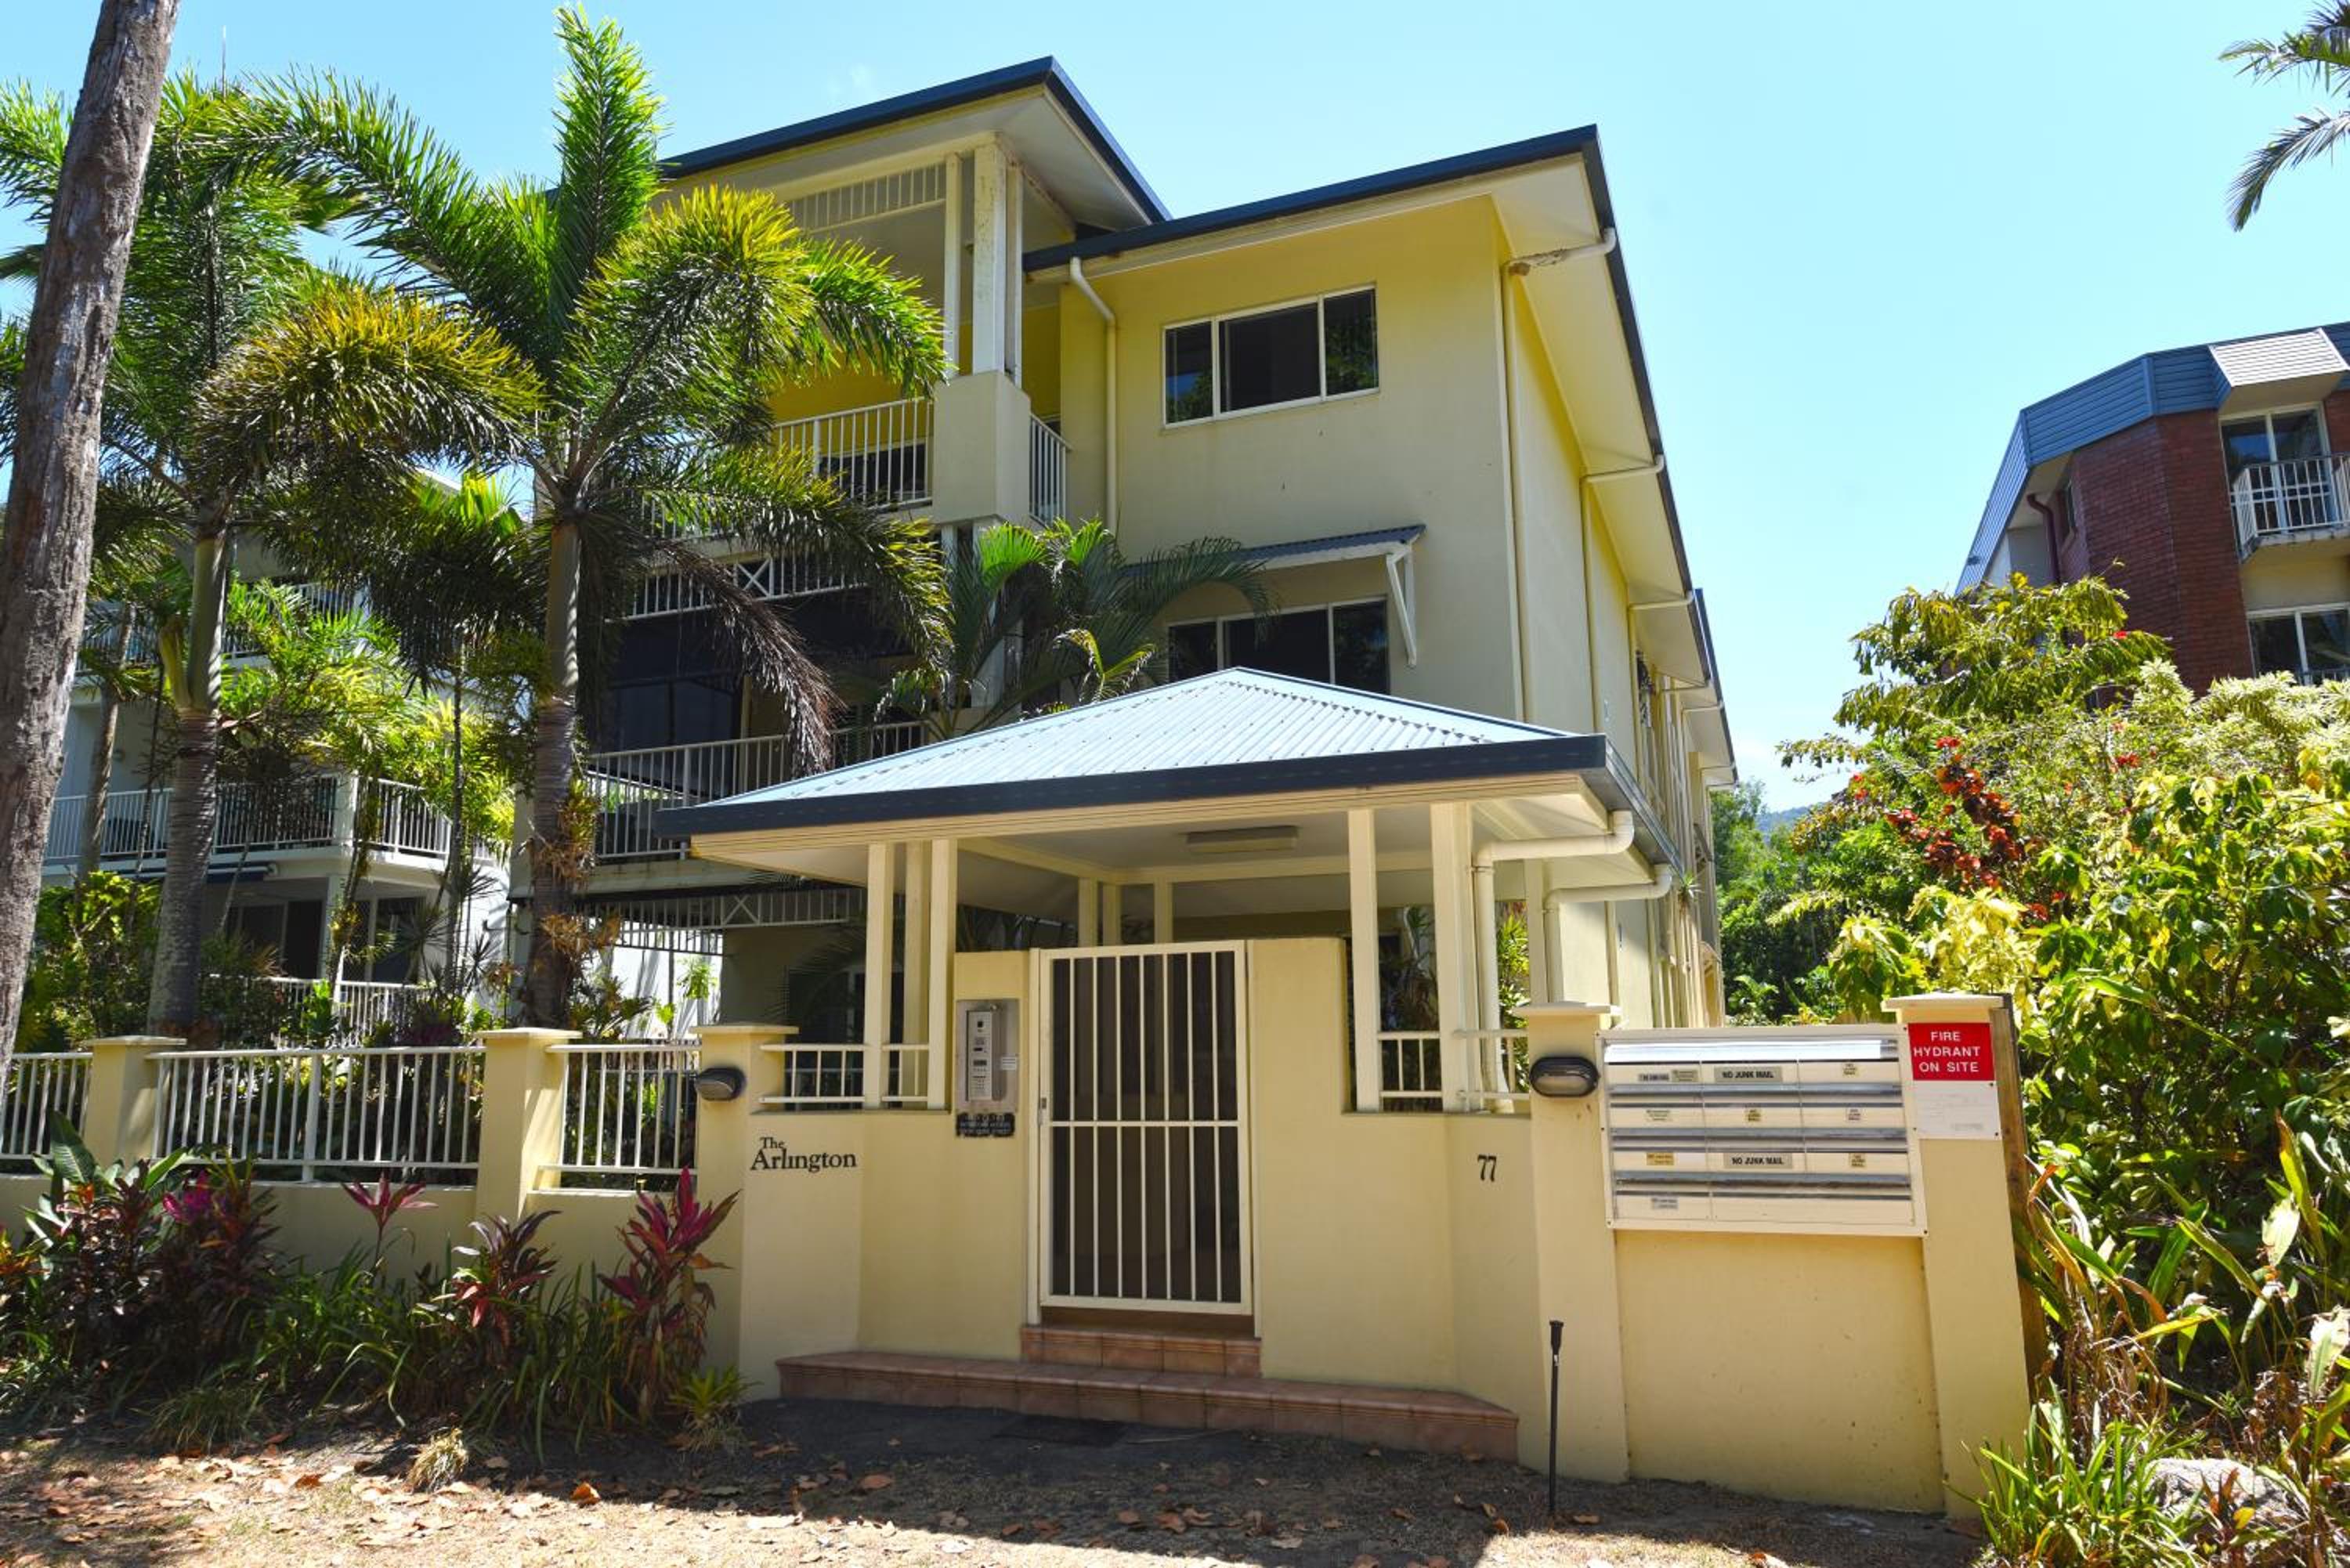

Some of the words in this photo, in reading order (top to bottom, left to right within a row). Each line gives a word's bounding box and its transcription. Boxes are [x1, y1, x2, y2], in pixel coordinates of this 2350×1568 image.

[1930, 1031, 1961, 1042] FIRE
[1913, 1046, 1981, 1057] HYDRANT
[1918, 1061, 1940, 1072] ON
[1947, 1061, 1979, 1072] SITE
[759, 1136, 785, 1149] The
[750, 1147, 857, 1173] Arlington
[1477, 1154, 1497, 1183] 77
